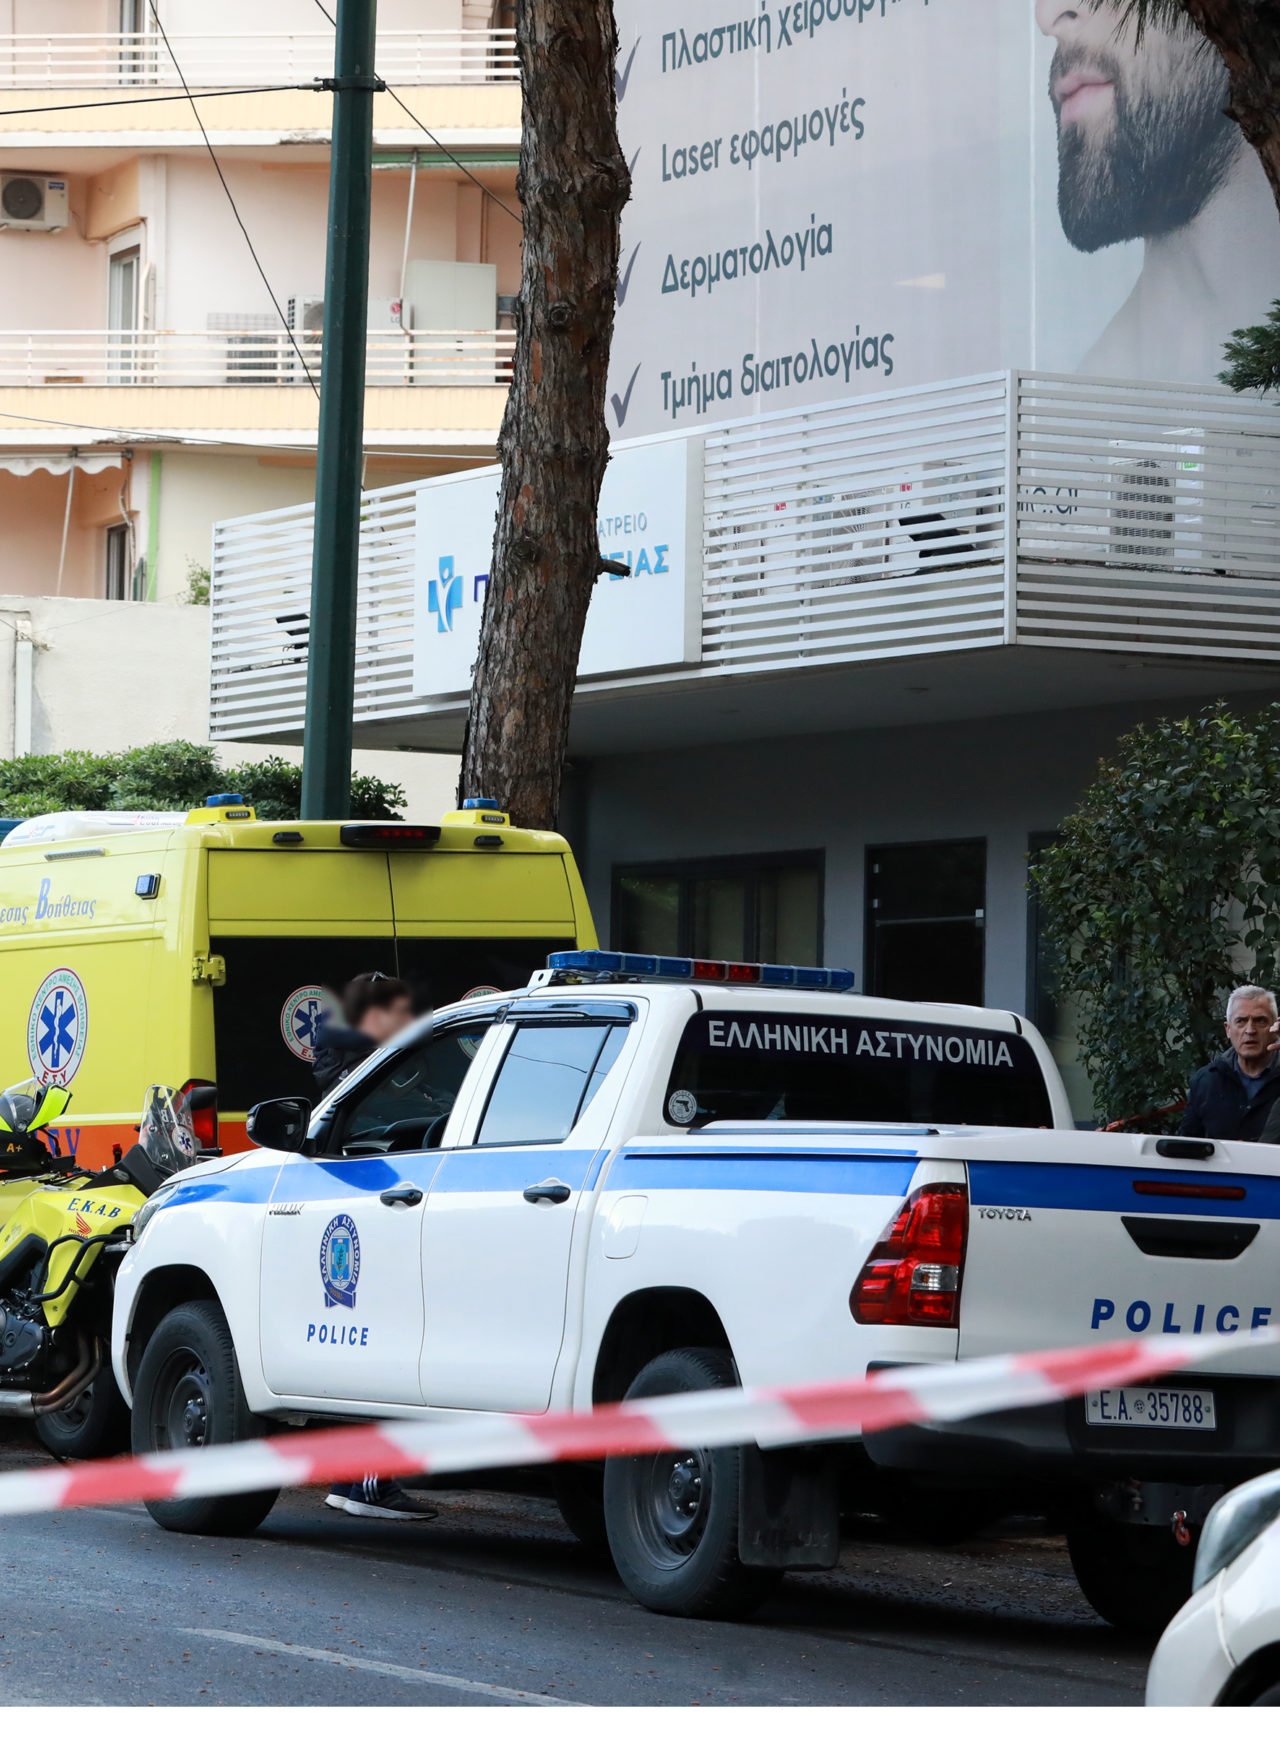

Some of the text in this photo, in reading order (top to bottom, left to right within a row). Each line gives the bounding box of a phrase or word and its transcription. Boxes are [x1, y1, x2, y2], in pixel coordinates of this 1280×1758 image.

[662, 1, 771, 73] Πλαστική
[661, 87, 867, 182] Laser εφαρμογές
[661, 212, 834, 295] Δερματολογία
[660, 324, 896, 419] Τμήμα διαιτολογίας
[35, 878, 97, 919] Βοήθειας
[708, 1020, 1014, 1067] ΕΛΛΗΝΙΚΗ ΑΣΤΥΝΟΜΙΑ
[978, 1208, 1032, 1221] TOYOTA
[307, 1323, 369, 1346] POLICE
[1091, 1298, 1272, 1338] POLICE
[1147, 1392, 1203, 1423] 35788
